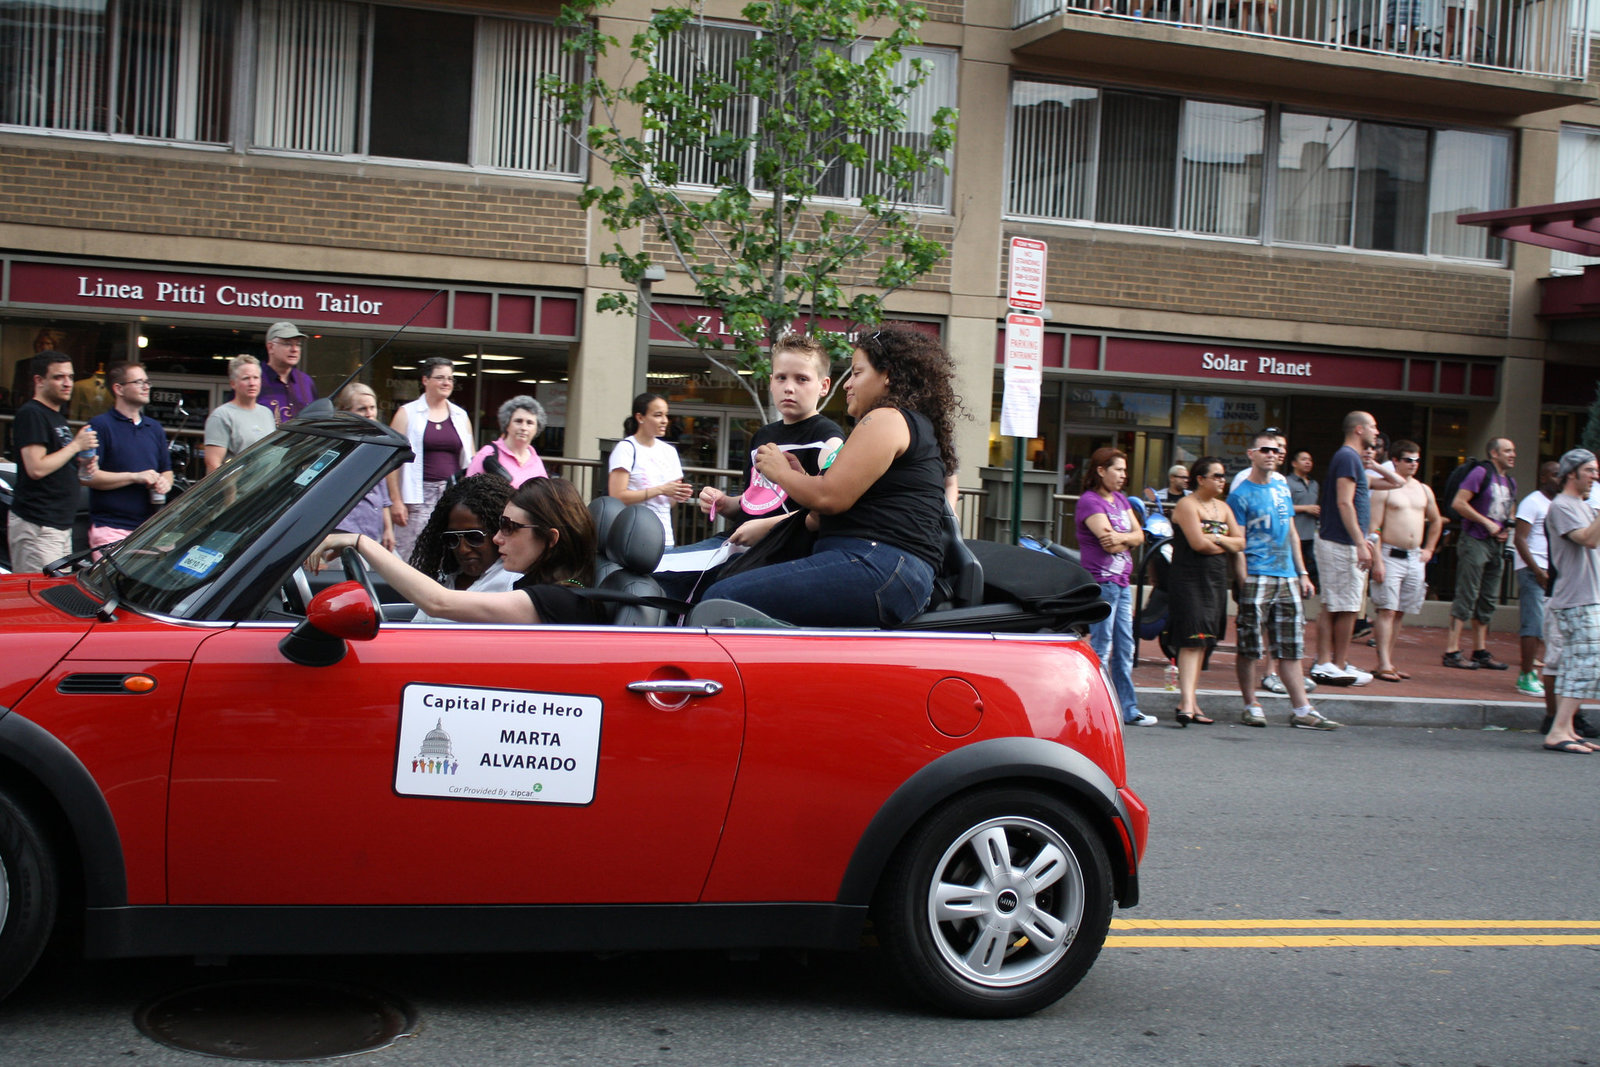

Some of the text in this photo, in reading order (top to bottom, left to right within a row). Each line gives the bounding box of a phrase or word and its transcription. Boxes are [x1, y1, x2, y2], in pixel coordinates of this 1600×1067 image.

[77, 276, 383, 315] Linea Pitti Custom Tailor
[696, 315, 711, 334] Z
[1019, 328, 1030, 337] NO
[1010, 339, 1038, 350] PARKING
[1010, 351, 1038, 360] ENTRANCE
[1202, 352, 1312, 376] Solar Planet
[422, 693, 583, 718] Capital Pride Hero
[499, 729, 561, 747] MARTA
[479, 752, 577, 772] ALVARADO
[448, 785, 463, 794] Car
[464, 786, 498, 796] Provided
[498, 788, 508, 797] By
[510, 789, 534, 798] zipcar
[1000, 897, 1016, 907] MINI
